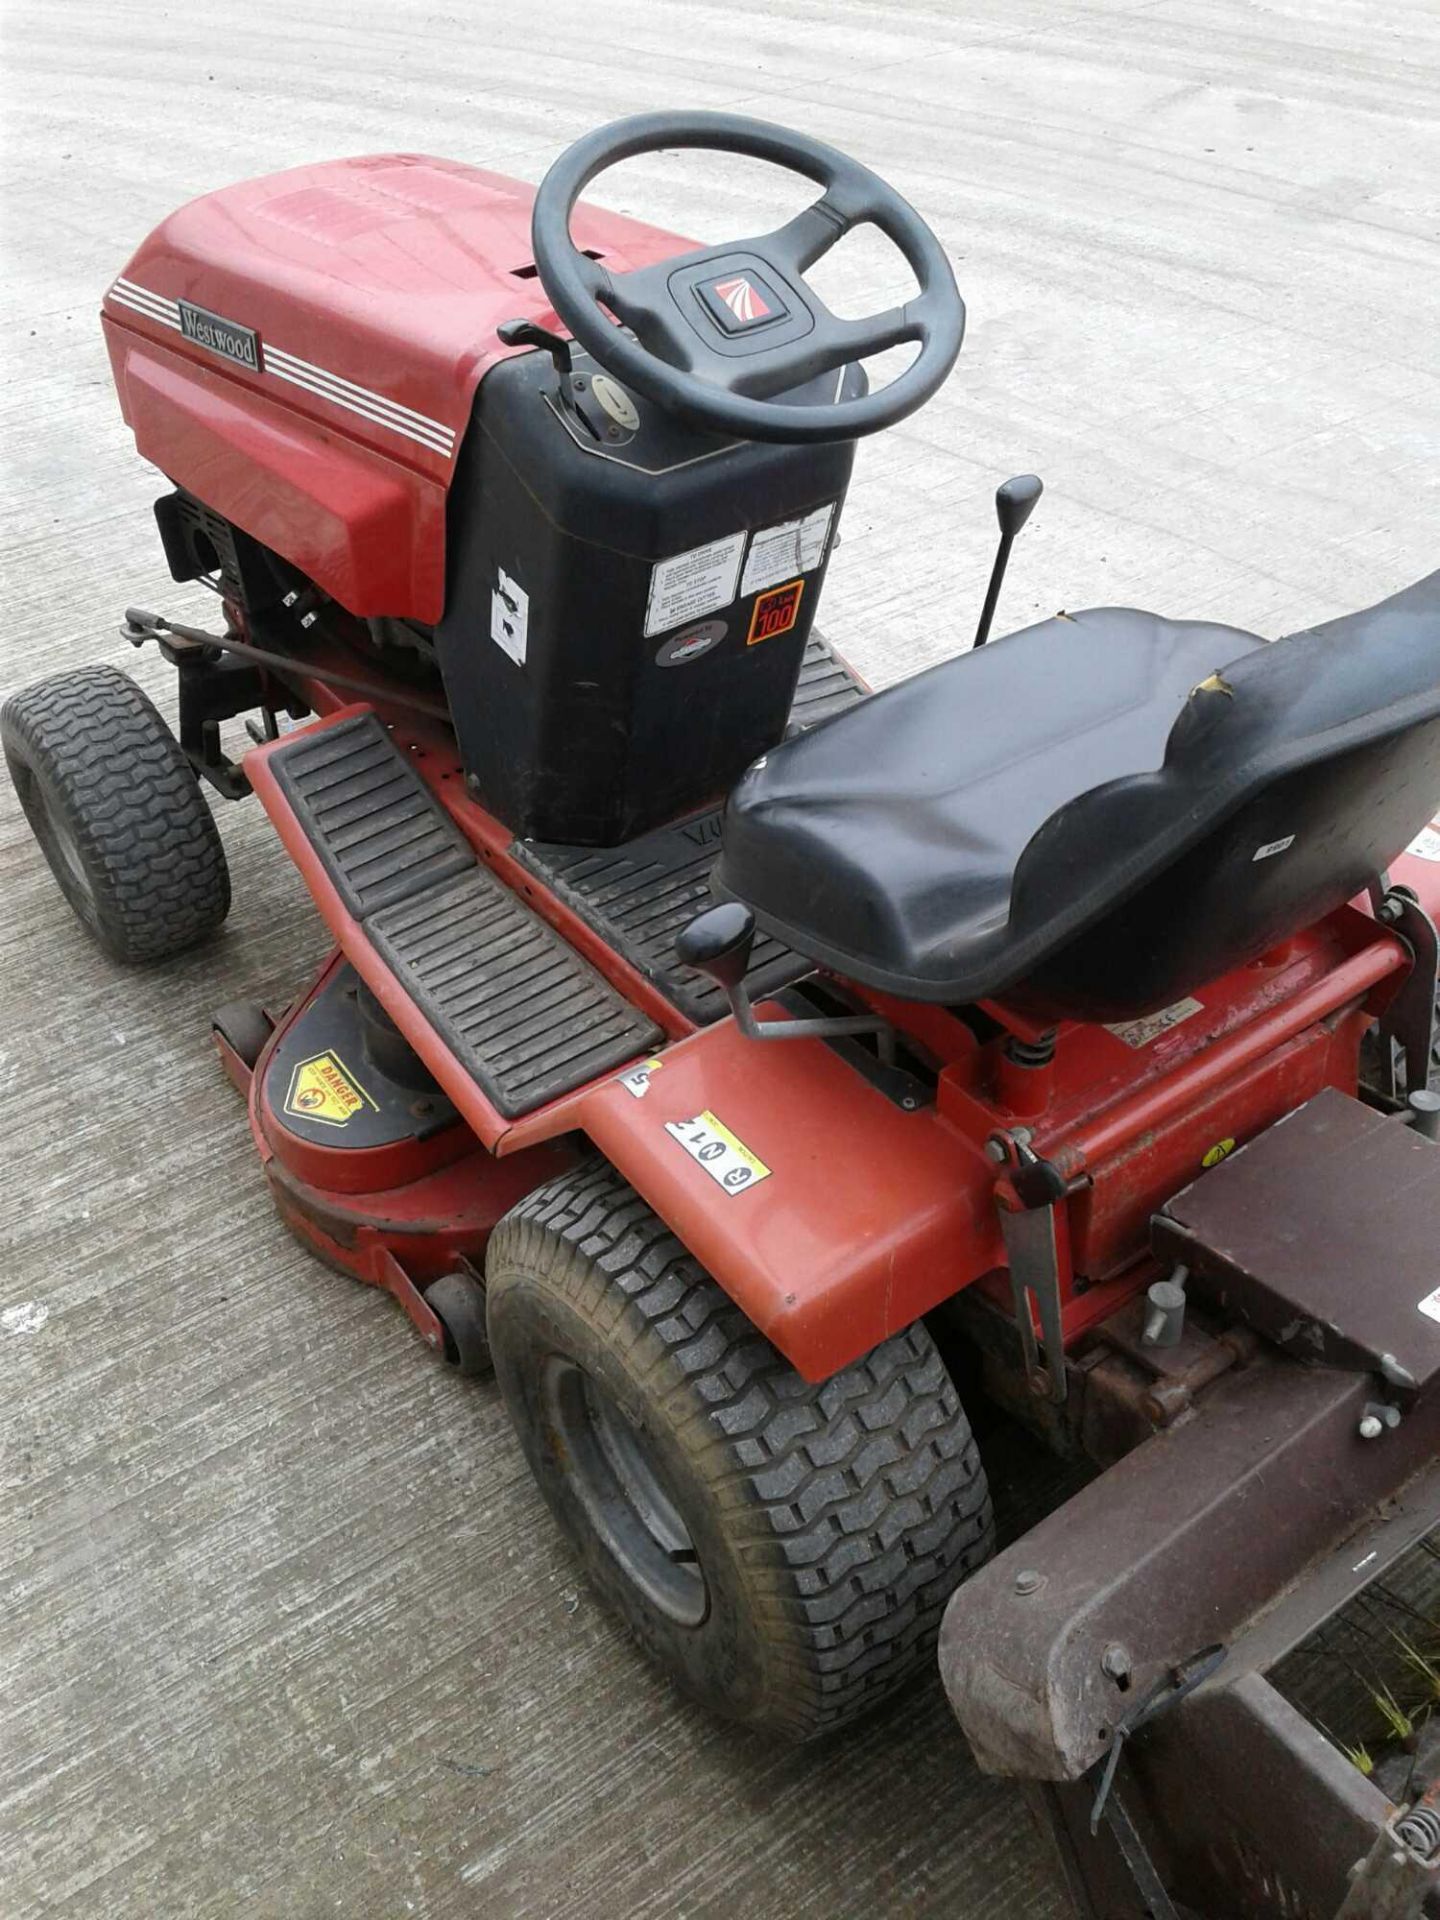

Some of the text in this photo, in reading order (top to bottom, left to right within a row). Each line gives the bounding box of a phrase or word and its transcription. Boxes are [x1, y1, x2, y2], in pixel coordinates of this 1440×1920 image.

[181, 307, 254, 363] Westwood
[759, 605, 792, 637] 100
[321, 1066, 358, 1107] DANGER
